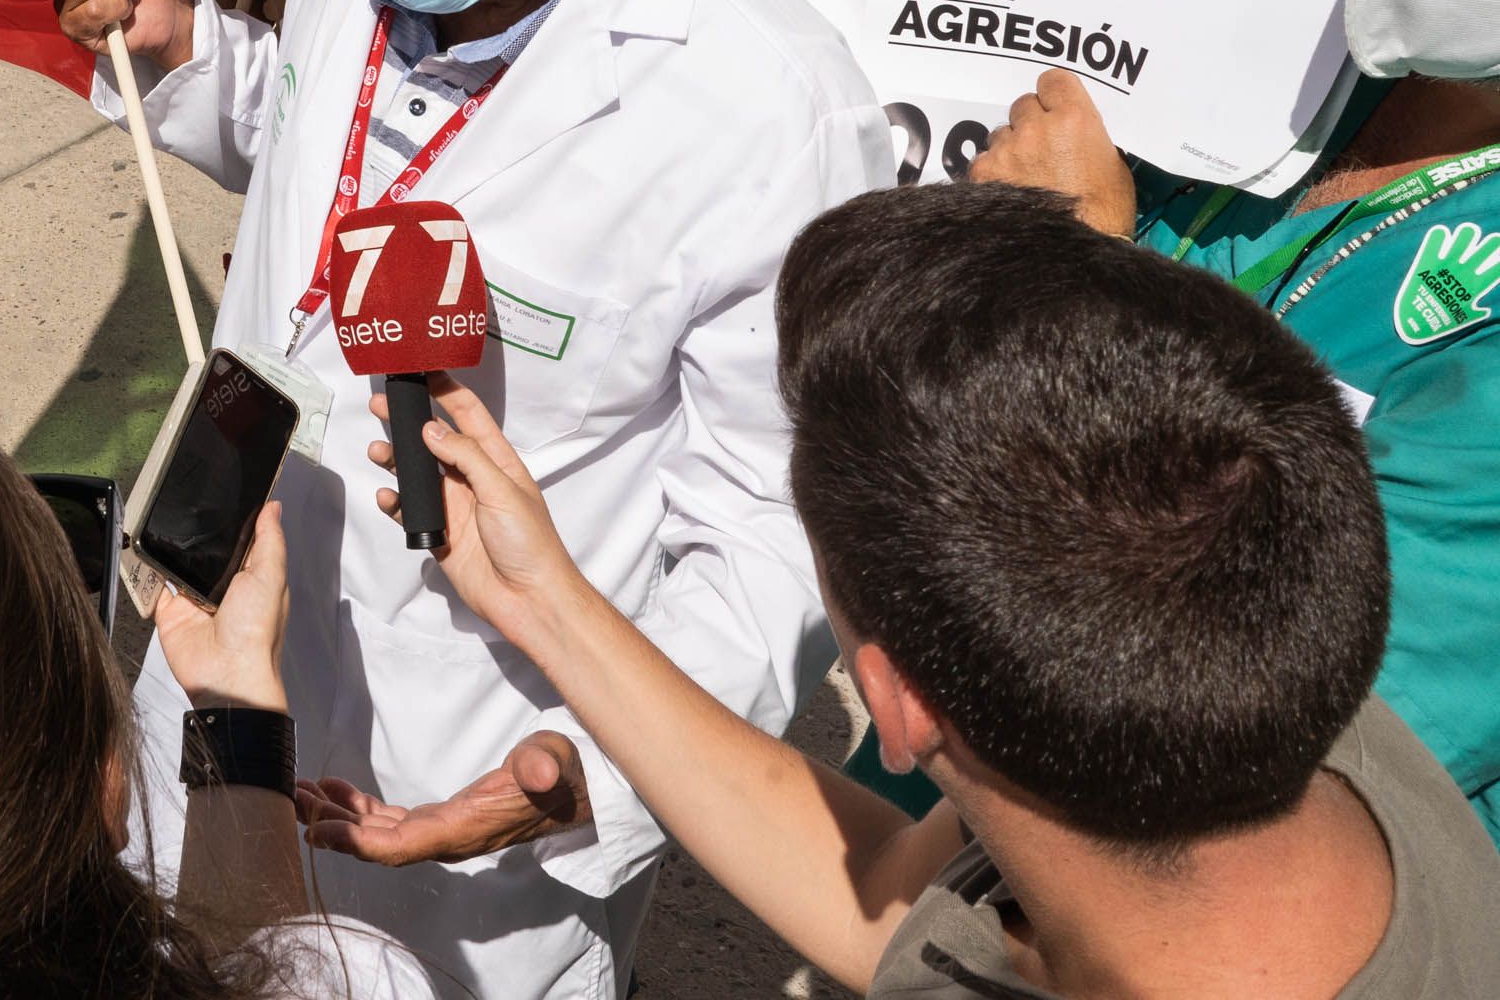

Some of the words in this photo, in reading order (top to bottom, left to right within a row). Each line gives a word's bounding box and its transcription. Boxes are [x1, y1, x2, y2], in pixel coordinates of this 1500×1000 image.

[889, 0, 1149, 87] AGRESIÓN
[337, 225, 396, 317] 7
[418, 219, 468, 306] 7
[1437, 268, 1472, 302] #STOP
[338, 317, 403, 347] siete
[428, 309, 486, 338] siete
